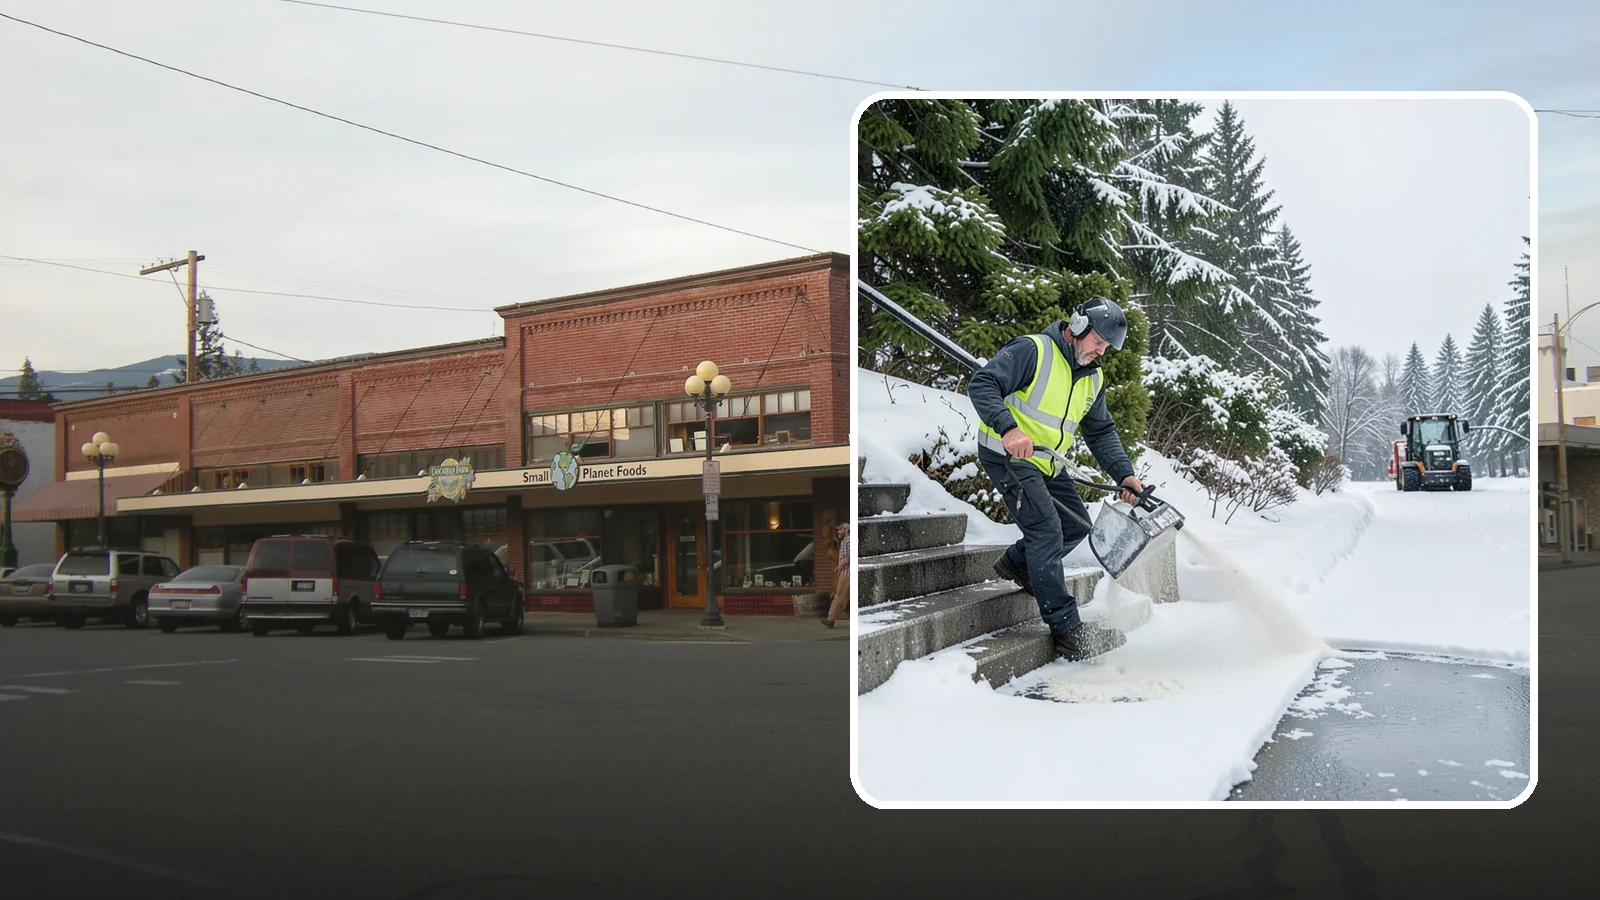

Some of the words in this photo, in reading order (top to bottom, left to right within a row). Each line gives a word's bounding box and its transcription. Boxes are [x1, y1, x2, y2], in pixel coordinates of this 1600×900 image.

[523, 471, 549, 483] Small
[583, 467, 614, 479] Planet
[617, 464, 647, 477] Foods
